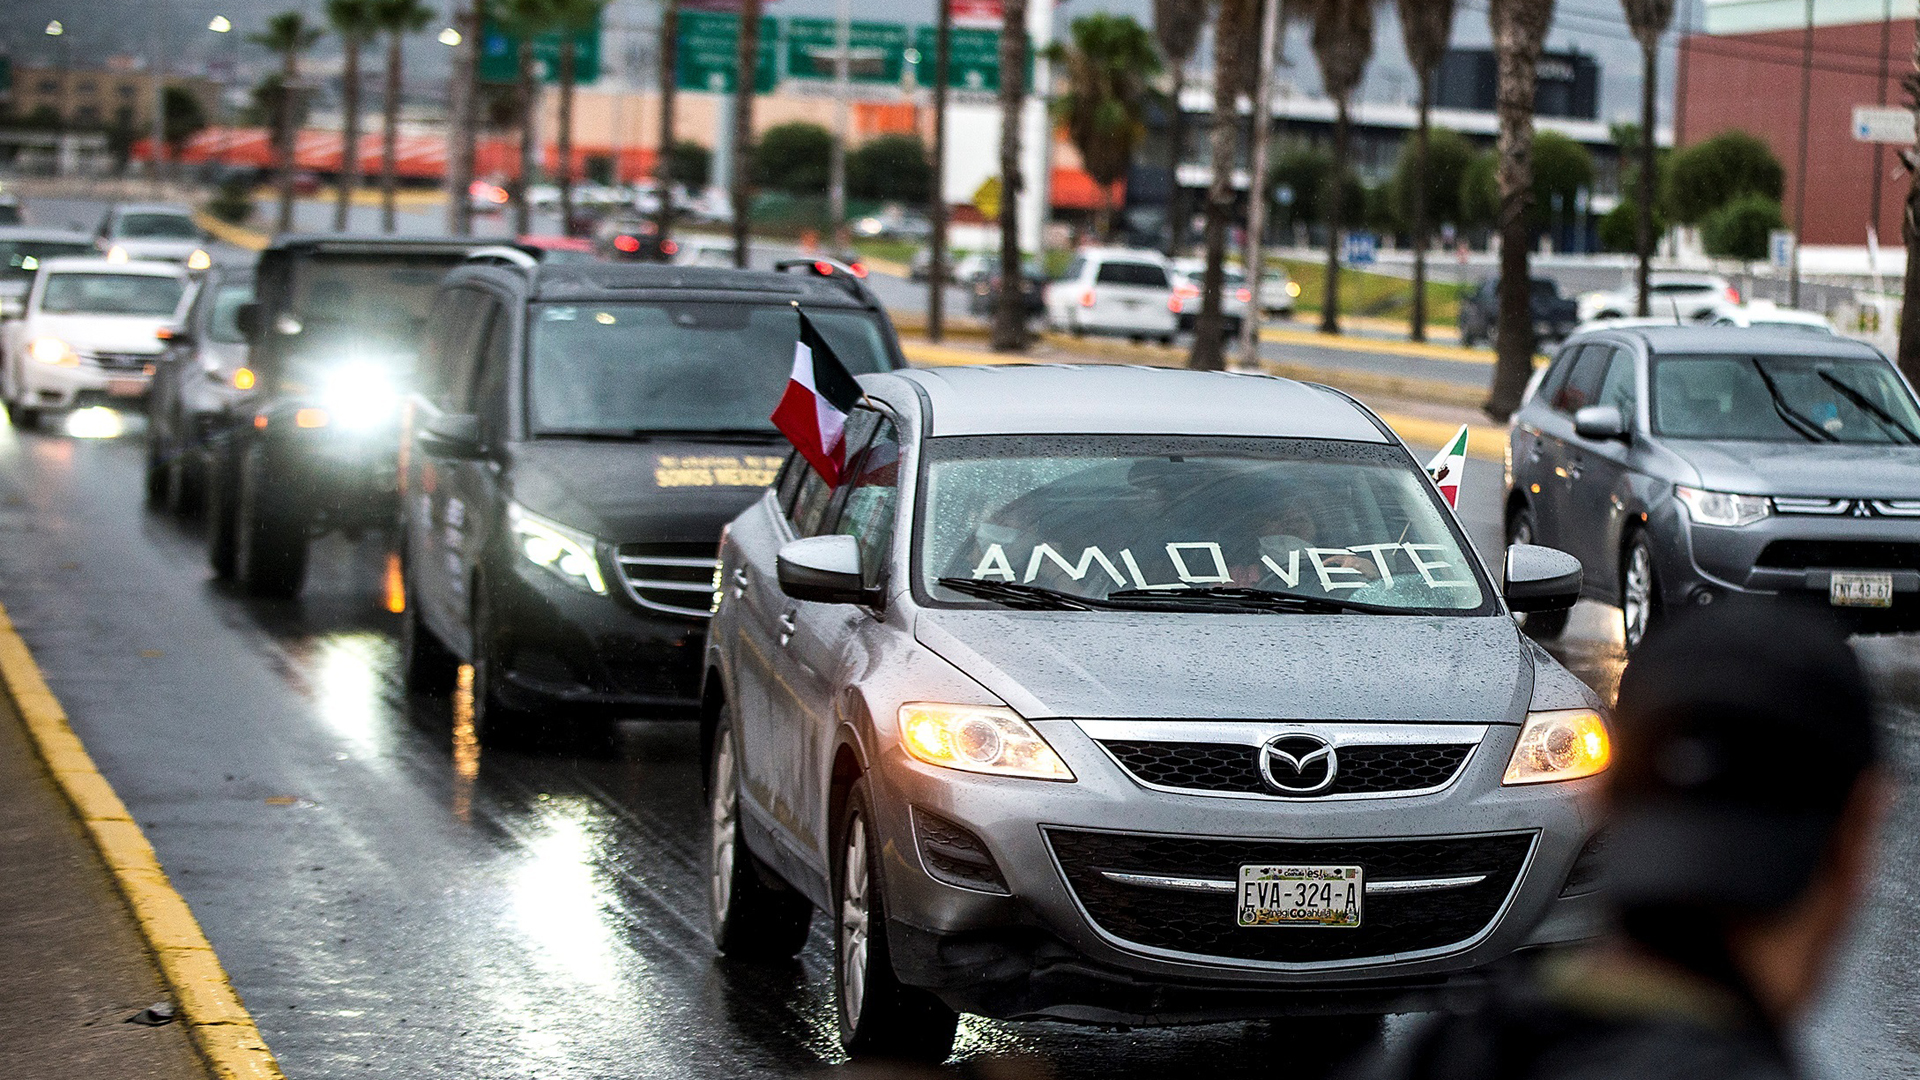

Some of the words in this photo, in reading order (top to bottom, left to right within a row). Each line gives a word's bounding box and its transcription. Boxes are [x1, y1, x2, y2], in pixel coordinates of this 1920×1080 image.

[972, 542, 1235, 590] AMLO
[1261, 542, 1475, 592] VETE
[1244, 882, 1357, 908] EVA-324-A
